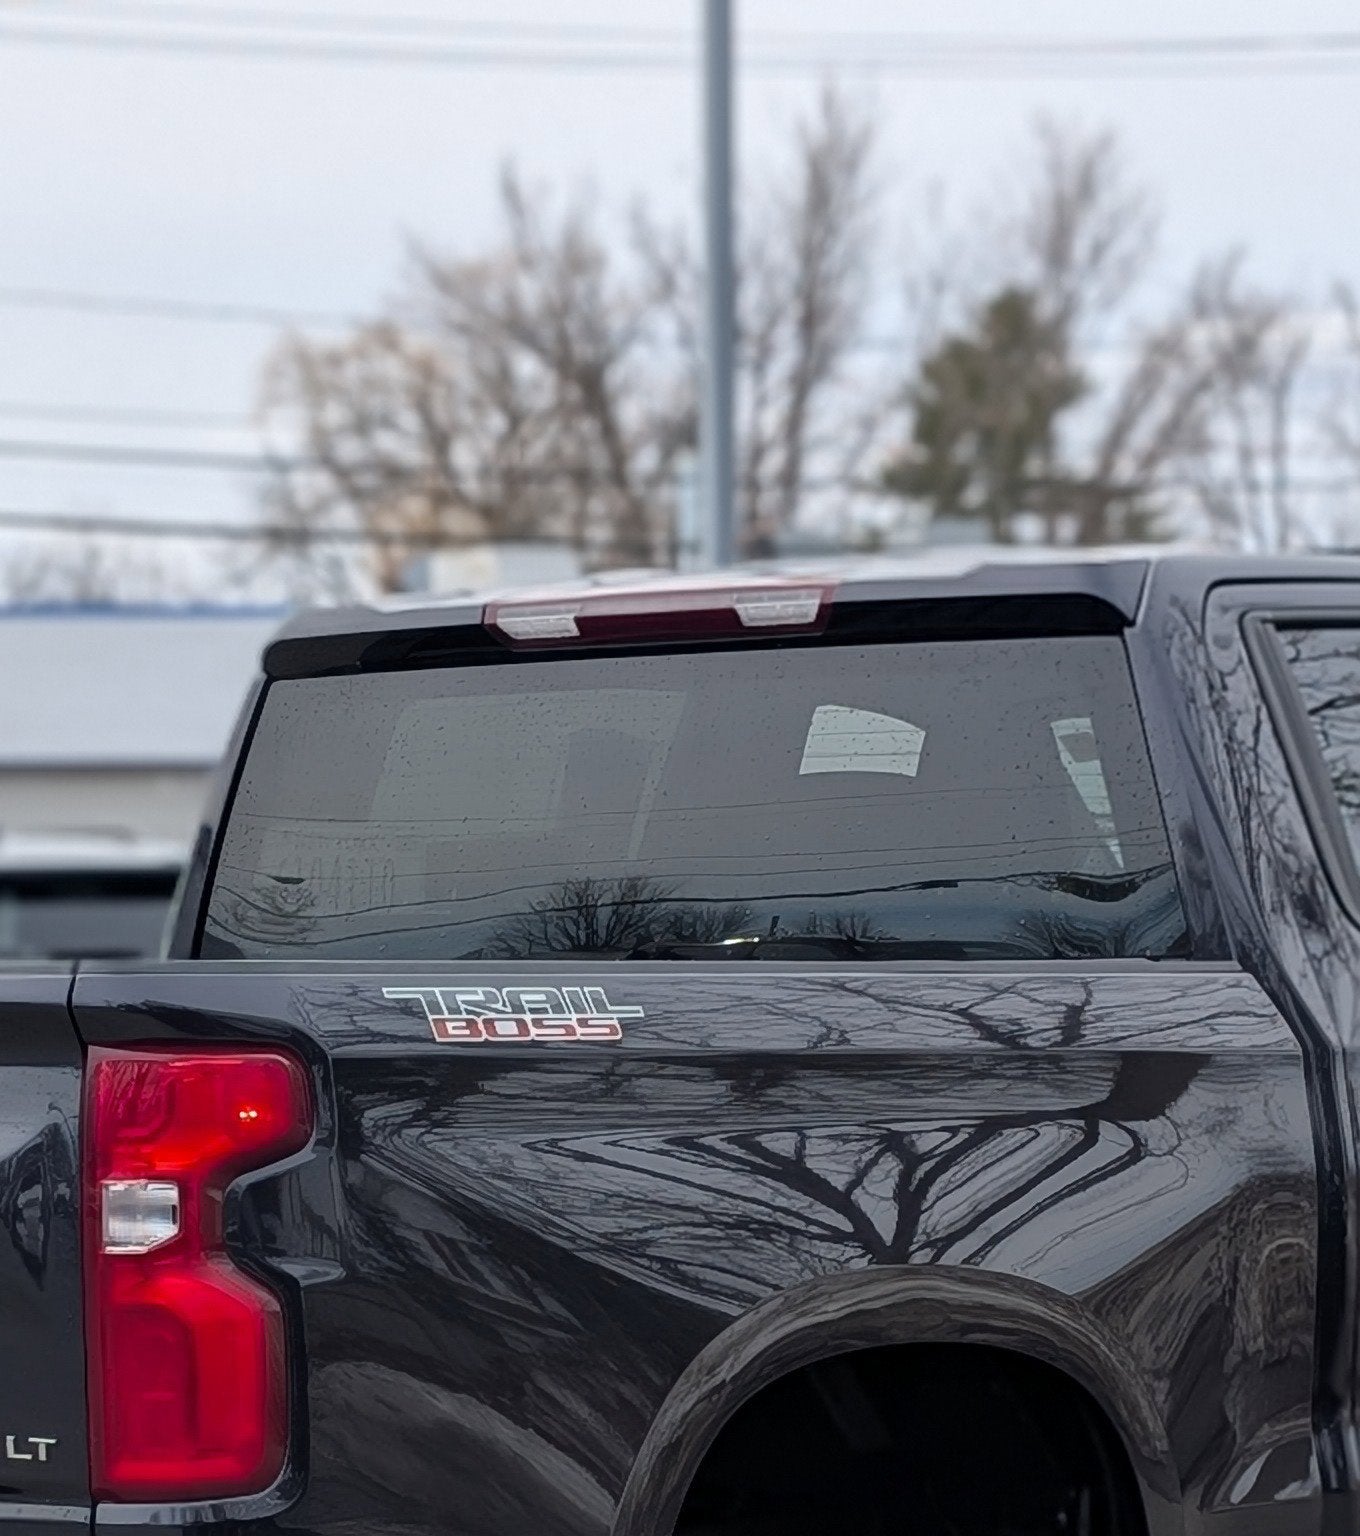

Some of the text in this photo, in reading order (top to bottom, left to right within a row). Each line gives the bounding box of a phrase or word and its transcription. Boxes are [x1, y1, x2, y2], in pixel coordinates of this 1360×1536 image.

[381, 986, 645, 1018] TRAIL
[428, 1014, 623, 1042] BOSS
[5, 1434, 58, 1461] LT
